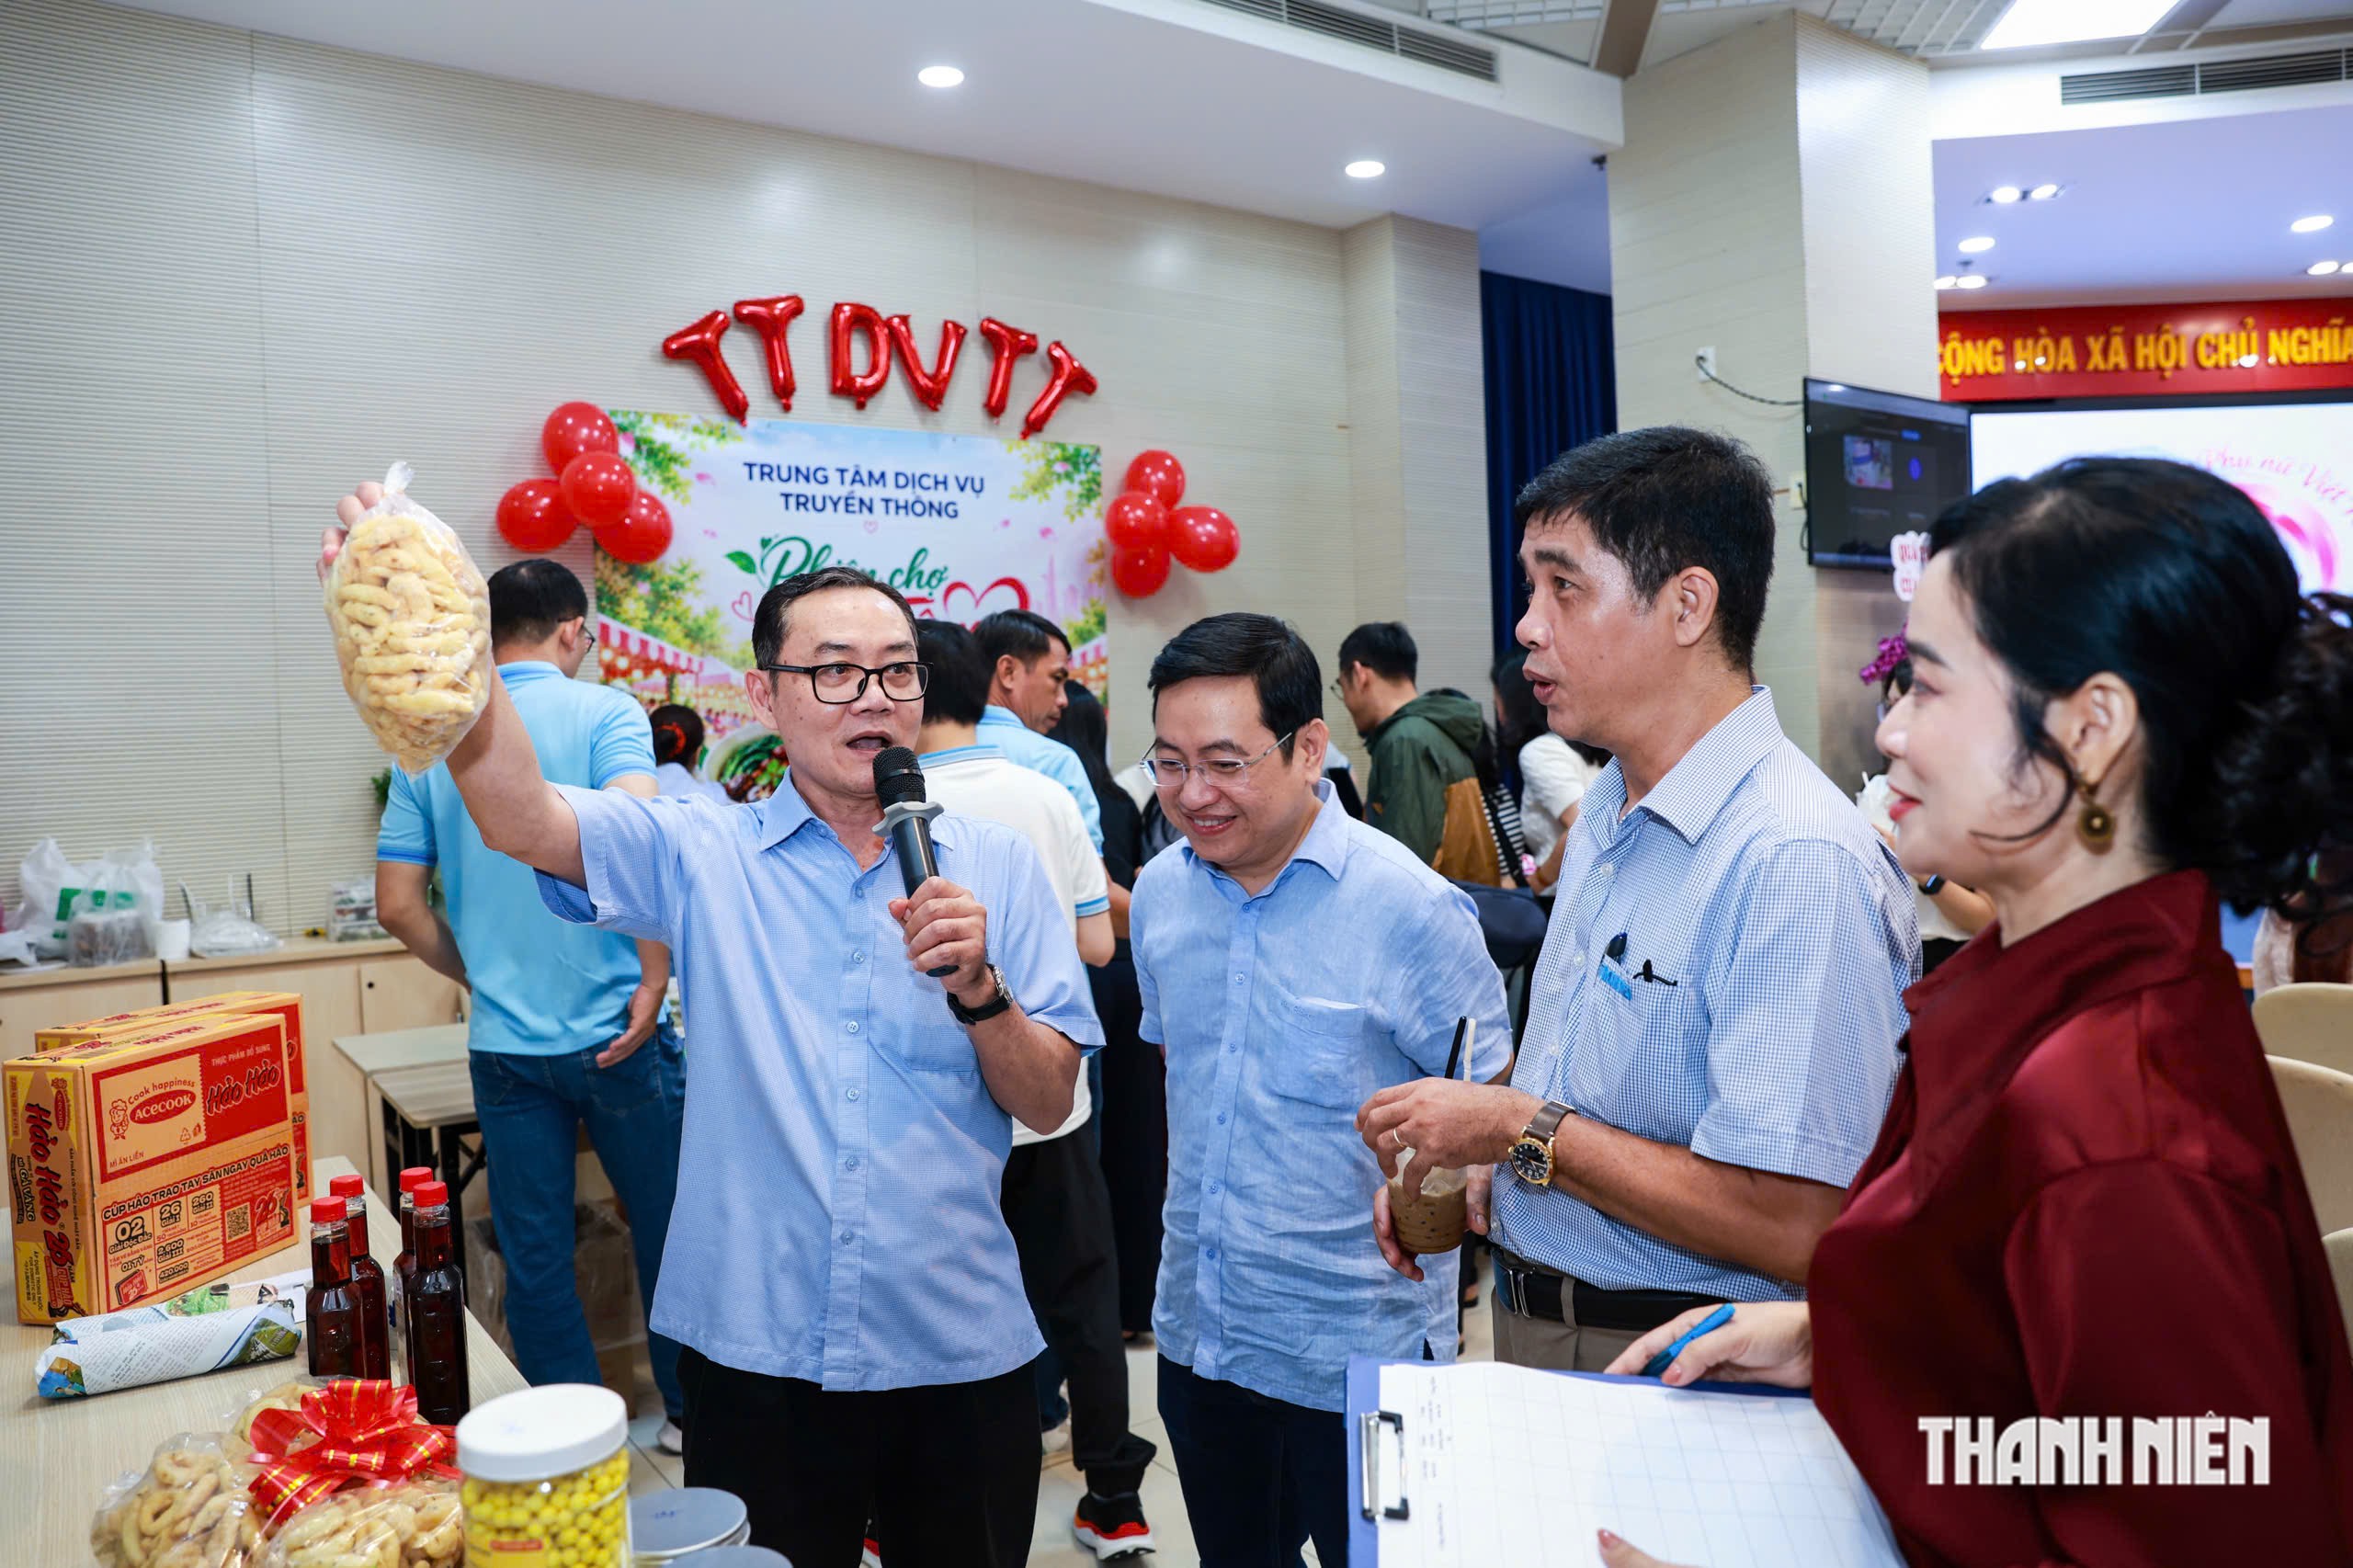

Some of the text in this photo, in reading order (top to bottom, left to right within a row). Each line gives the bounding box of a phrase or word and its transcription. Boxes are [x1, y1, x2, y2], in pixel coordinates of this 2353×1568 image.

[2014, 326, 2076, 373] HÒA
[2086, 325, 2127, 371] XÃ
[2134, 324, 2188, 379] HỘI
[2197, 316, 2258, 369] CHỦ
[743, 462, 984, 498] TRUNG TÂM DỊCH VỤ
[779, 490, 960, 519] TRUYỀN THÔNG
[889, 547, 949, 597] chợ
[128, 1077, 196, 1105] Cook happiness
[206, 1059, 281, 1116] Hảo Hảo
[25, 1103, 69, 1226] Hảo Hảo
[109, 1150, 144, 1168] MÌ ĂN LIỀN
[103, 1145, 289, 1220] CÚP HẢO TRAO TAY SĂN NGAY QUÀ HẢO
[22, 1187, 36, 1221] VÀNG
[160, 1200, 182, 1221] 26
[192, 1191, 213, 1207] 260
[116, 1216, 144, 1242] 02
[161, 1215, 176, 1227] Giải
[43, 1230, 74, 1267] 26
[108, 1242, 124, 1255] Giải
[157, 1238, 184, 1256] 2.600
